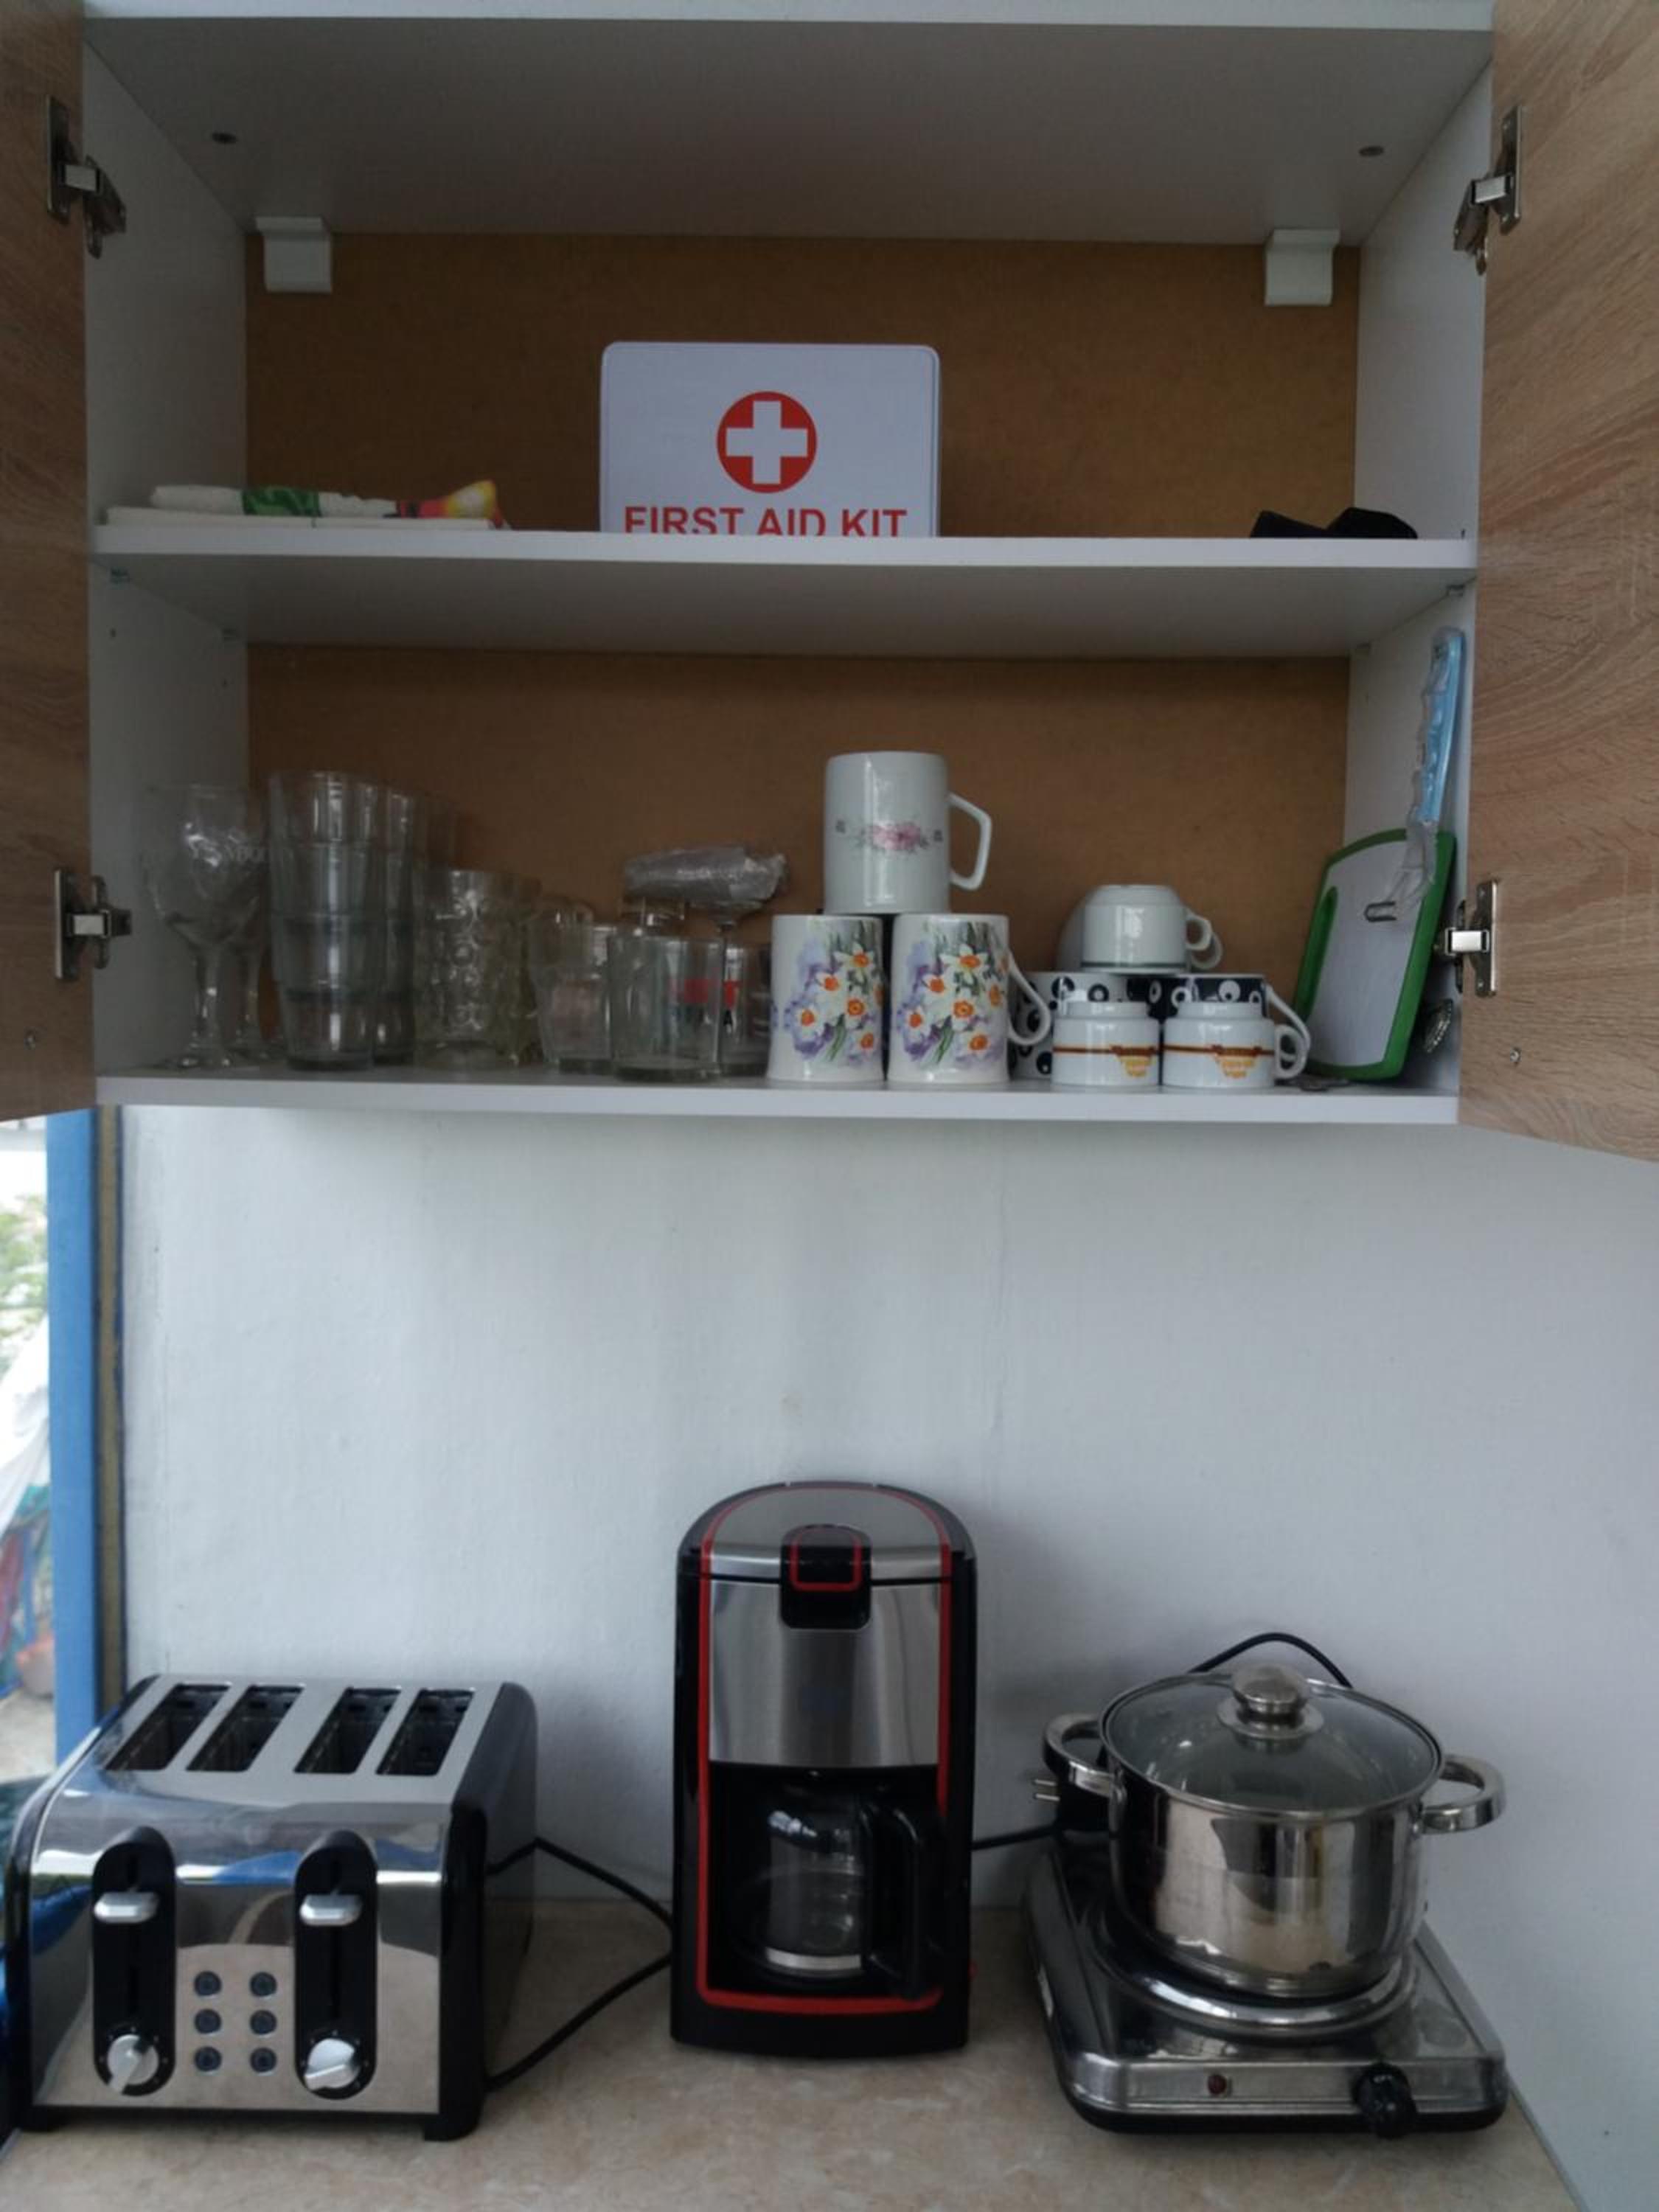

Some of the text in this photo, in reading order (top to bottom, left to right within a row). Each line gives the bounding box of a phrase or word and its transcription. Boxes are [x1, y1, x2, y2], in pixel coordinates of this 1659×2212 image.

[625, 506, 908, 537] FIRST AID KIT
